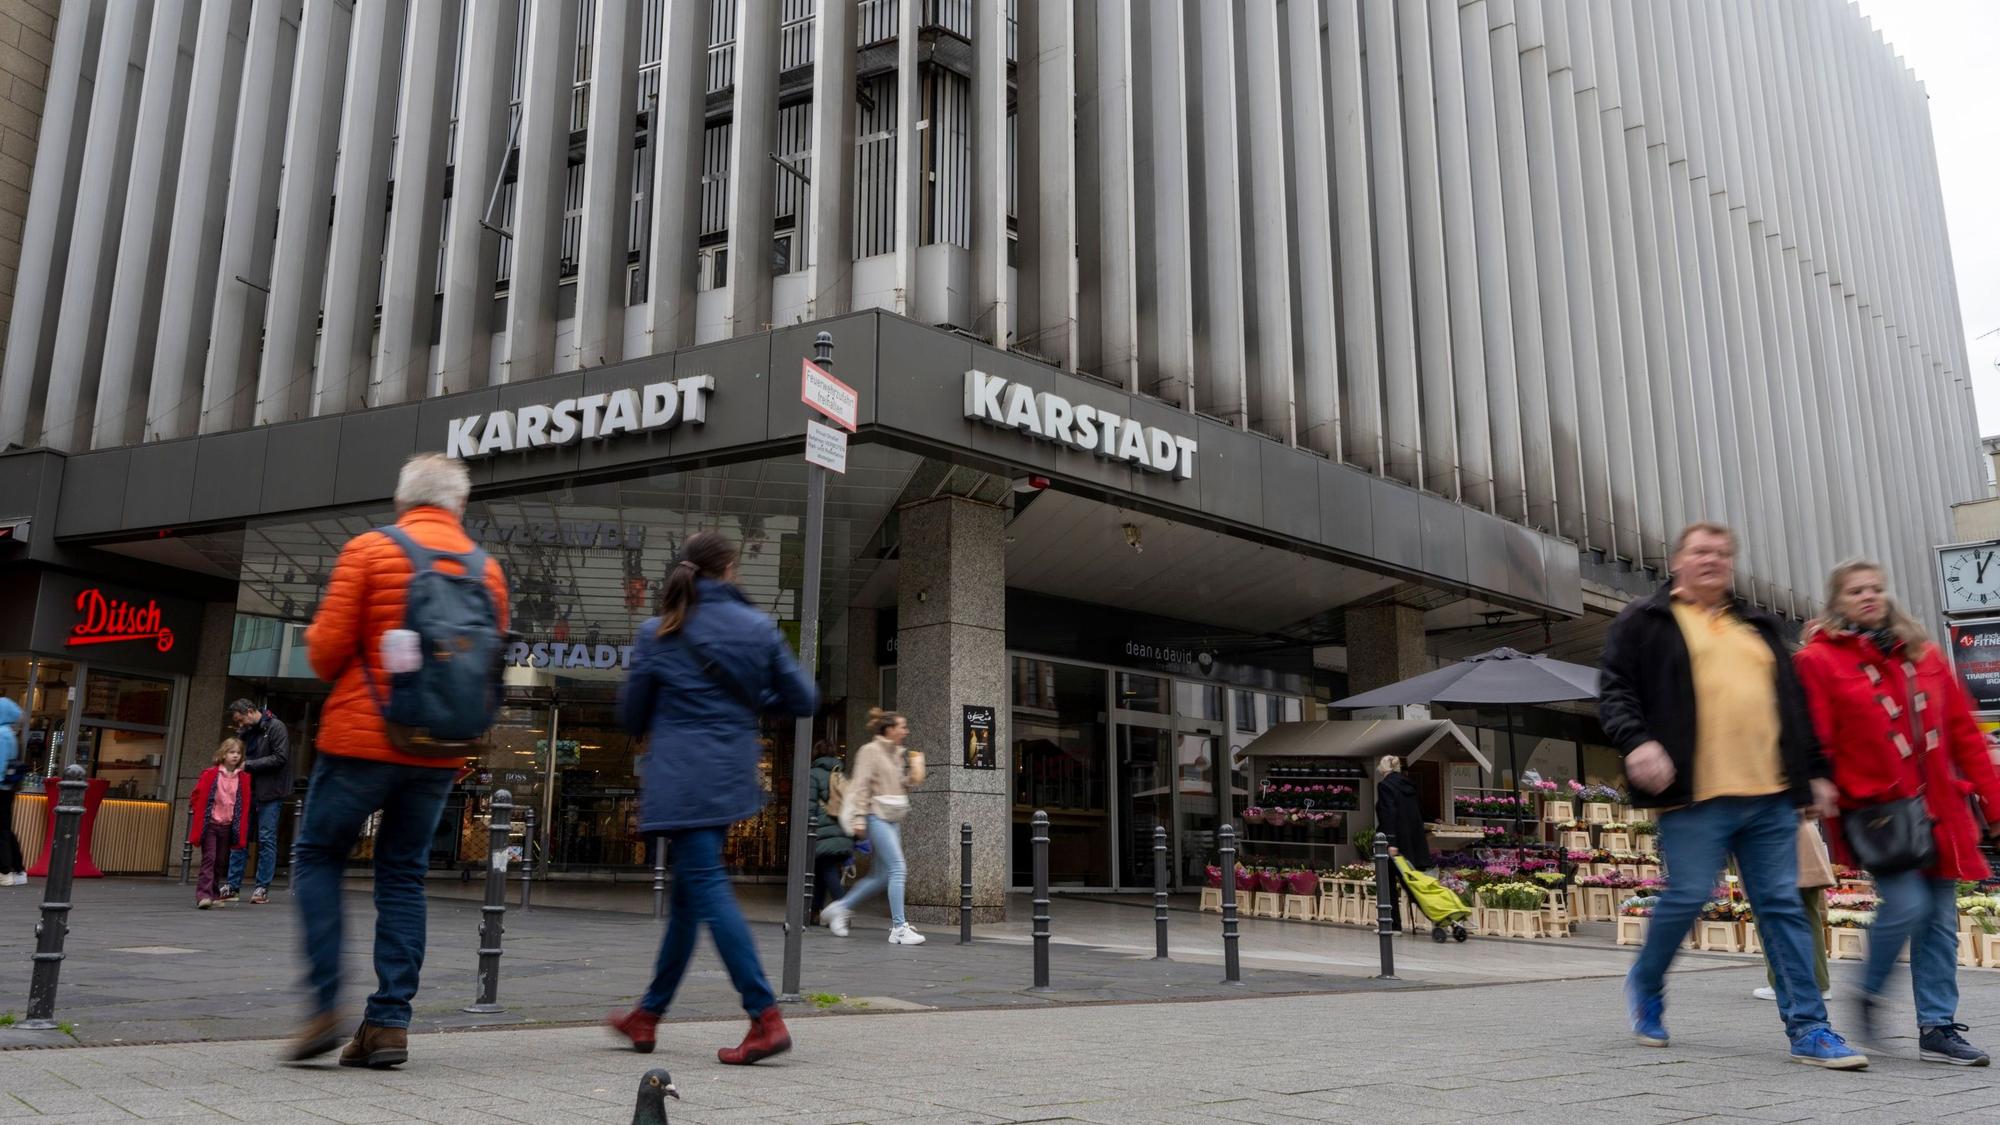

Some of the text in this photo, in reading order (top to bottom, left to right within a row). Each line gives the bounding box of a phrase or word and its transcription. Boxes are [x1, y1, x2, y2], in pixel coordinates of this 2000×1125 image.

[447, 374, 714, 458] KARSTADT
[964, 369, 1197, 479] KARSTADT
[75, 588, 161, 634] Ditsch
[504, 641, 636, 669] RSTADT
[1126, 640, 1192, 664] dean & david
